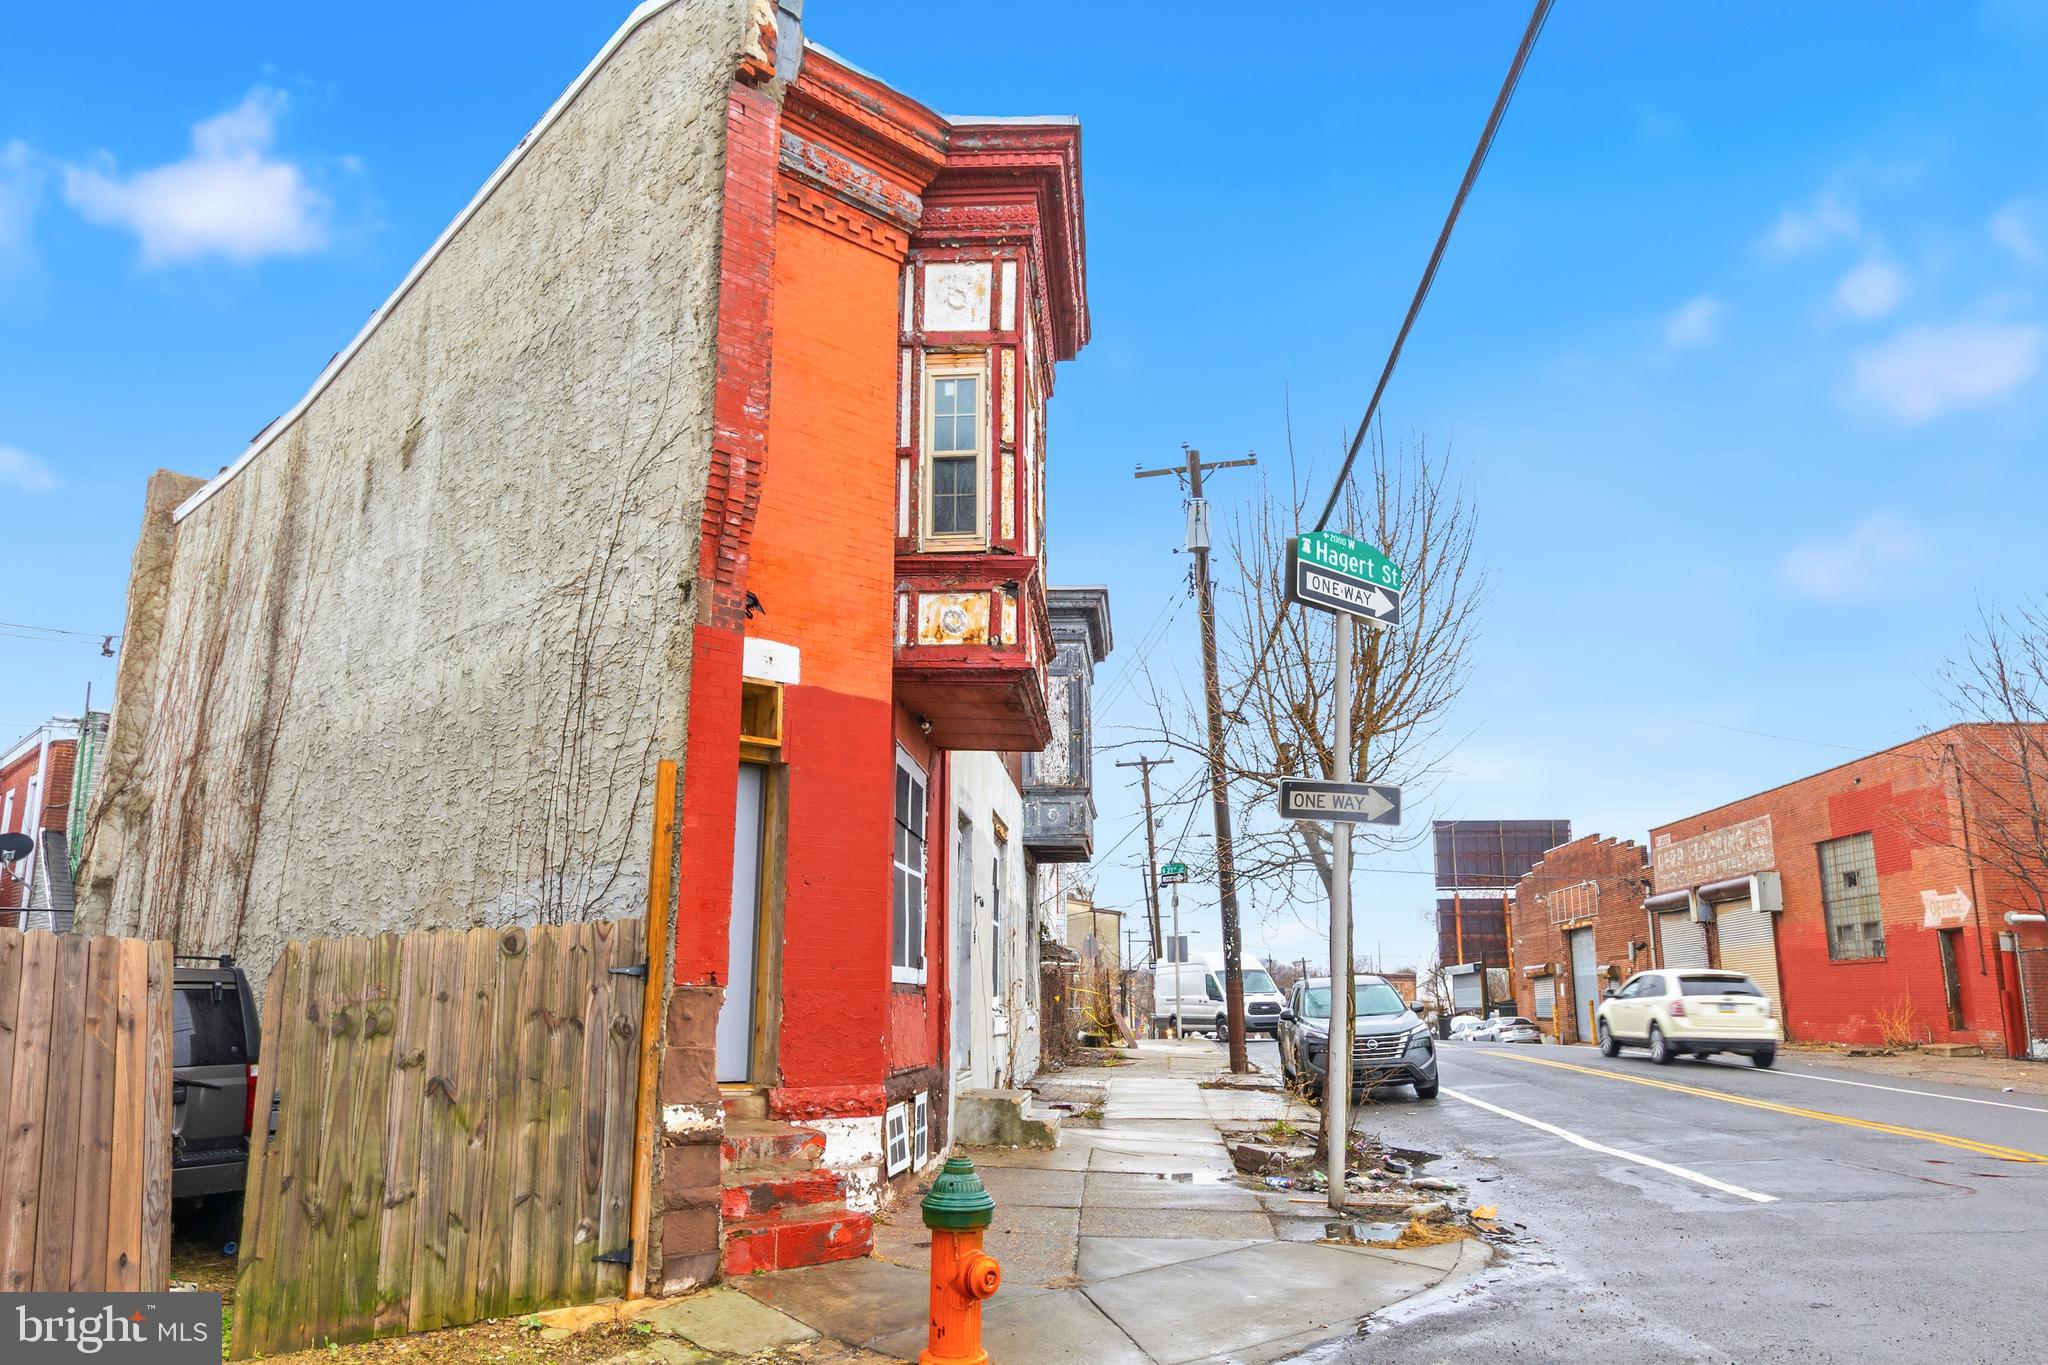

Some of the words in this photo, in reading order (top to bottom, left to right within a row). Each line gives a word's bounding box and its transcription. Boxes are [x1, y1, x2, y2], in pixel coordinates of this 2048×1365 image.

[1330, 534, 1347, 546] 2000
[1348, 538, 1356, 550] W
[1316, 540, 1374, 578] Hagert
[1382, 565, 1398, 586] St
[1312, 576, 1339, 596] ONE
[1344, 586, 1372, 606] WAY
[1294, 793, 1325, 808] ONE
[1333, 795, 1365, 811] WAY
